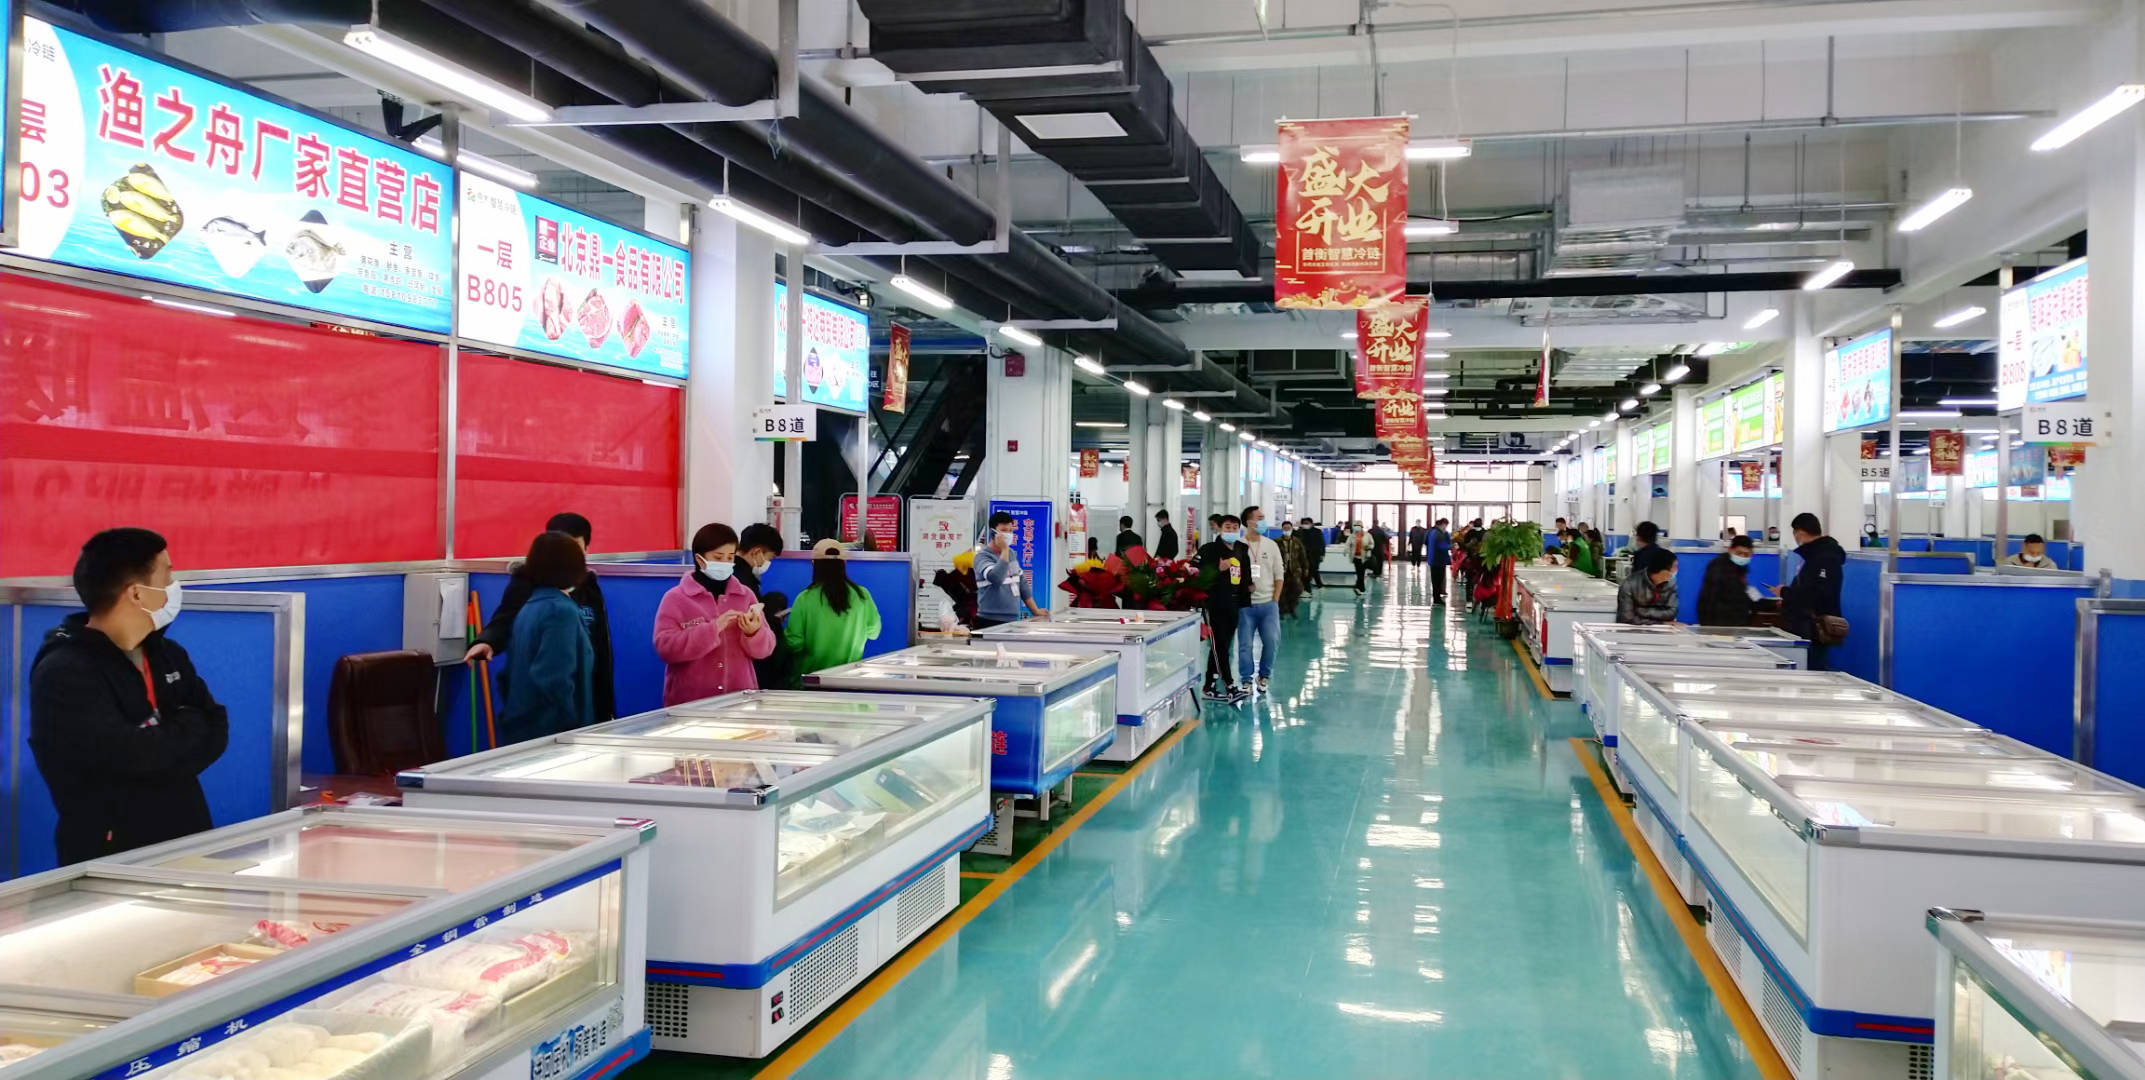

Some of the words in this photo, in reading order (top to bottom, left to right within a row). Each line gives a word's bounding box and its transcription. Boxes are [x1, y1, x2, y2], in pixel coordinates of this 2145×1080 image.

[98, 65, 441, 235] 渔之舟厂家直营店
[1298, 146, 1389, 203] 盛大
[1295, 197, 1384, 246] 开业
[477, 239, 513, 270] 一层
[561, 222, 685, 305] 北京鼎一食品有限公司
[1302, 246, 1381, 261] 首衡智慧冷链
[467, 273, 523, 312] B805
[1365, 336, 1414, 363] 开业
[765, 416, 805, 433] B8道
[2038, 417, 2094, 437] B8道
[124, 1018, 249, 1078] 压缩机
